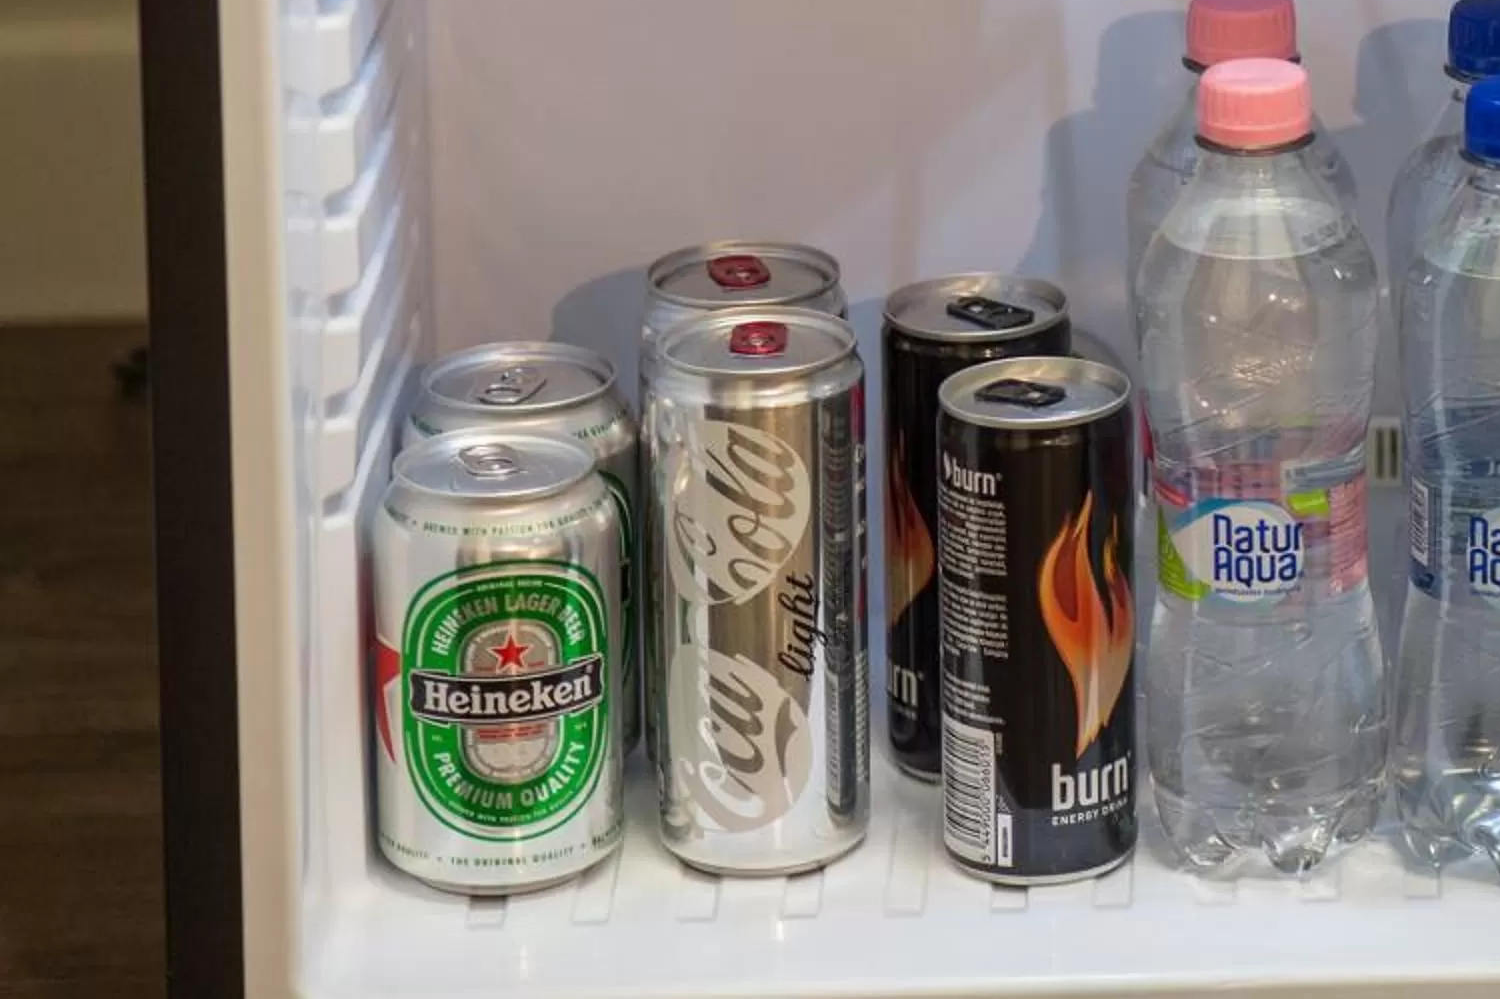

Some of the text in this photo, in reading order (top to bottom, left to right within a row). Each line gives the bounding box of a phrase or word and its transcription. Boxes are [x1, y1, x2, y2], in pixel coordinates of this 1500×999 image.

[952, 457, 996, 496] burn
[432, 595, 498, 656] HEINEKEN
[504, 592, 561, 617] LAGER
[777, 571, 826, 682] light
[423, 672, 594, 715] Heineken
[886, 662, 918, 706] rn
[433, 740, 586, 810] PREMIUM QUALITY
[1052, 757, 1129, 811] burn
[1051, 808, 1099, 827] ENERGY
